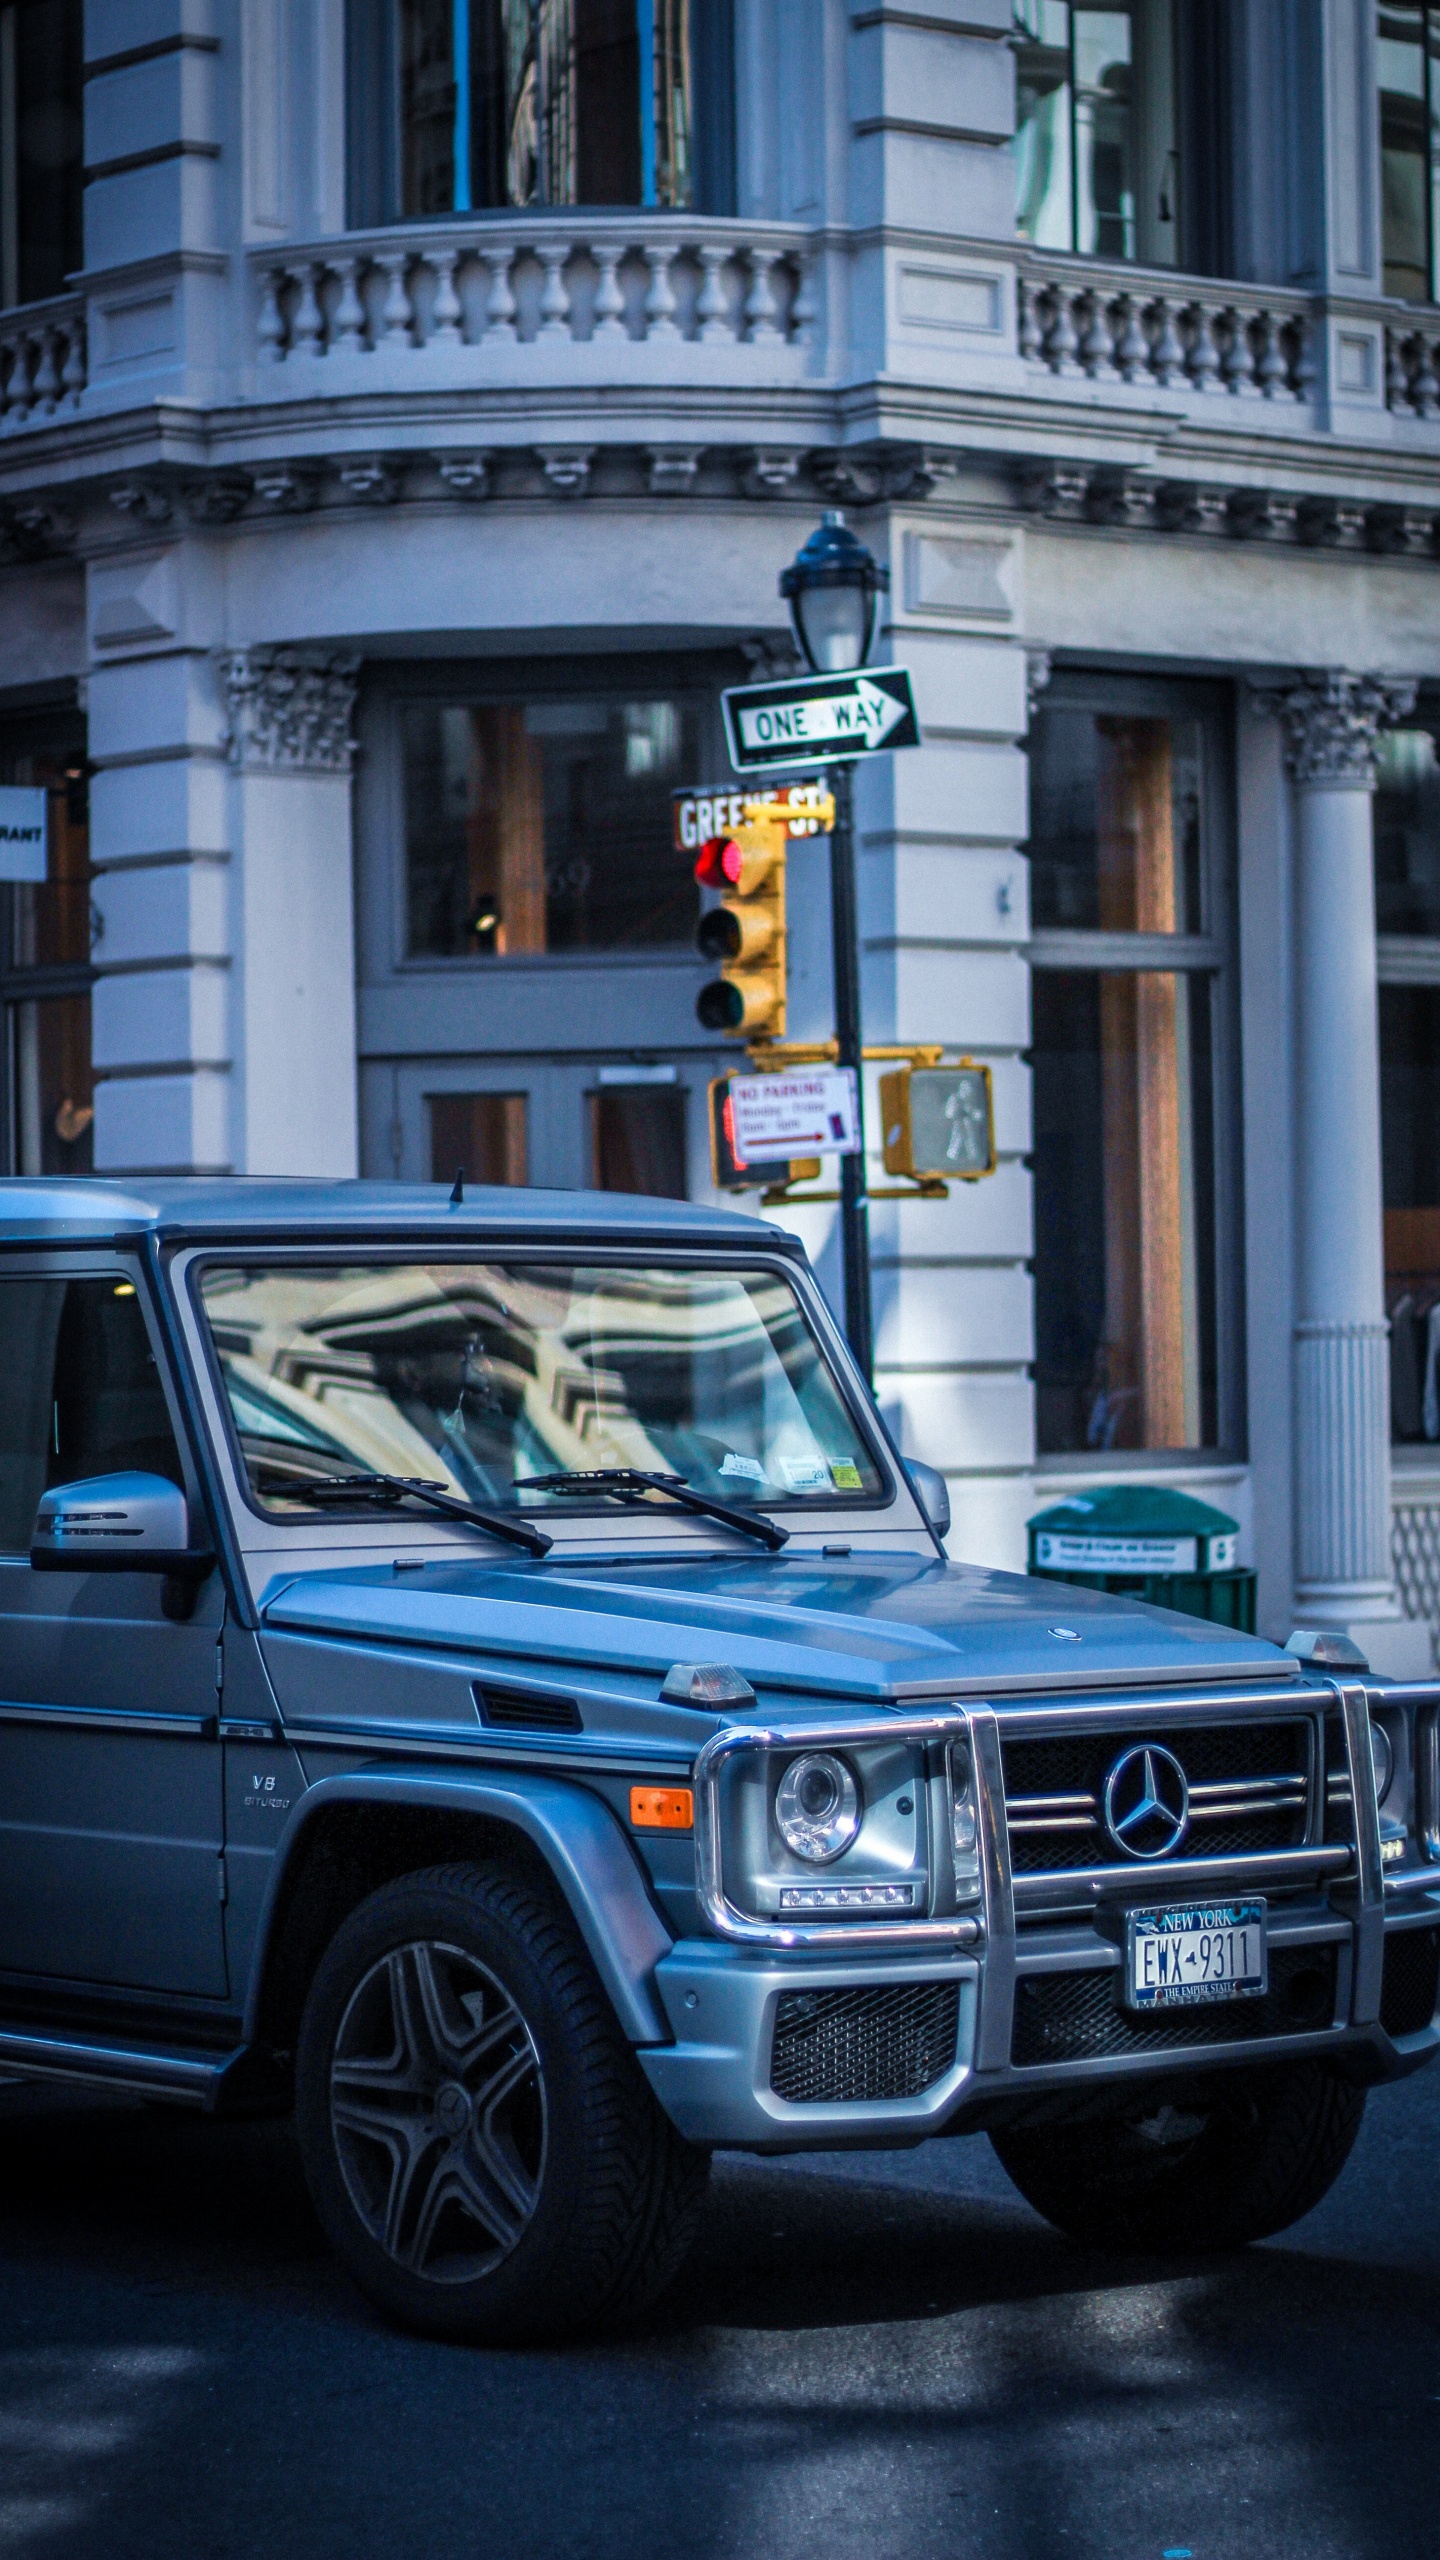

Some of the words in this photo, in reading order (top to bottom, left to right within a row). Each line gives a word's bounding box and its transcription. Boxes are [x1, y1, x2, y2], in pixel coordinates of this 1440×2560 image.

[757, 708, 808, 741] ONE
[831, 698, 885, 729] WAY
[252, 1775, 276, 1791] V8
[1163, 1912, 1195, 1933] NEW
[1197, 1908, 1232, 1930] YORK
[1144, 1937, 1183, 1987] EWX
[1199, 1930, 1249, 1980] 9311
[1164, 1988, 1180, 1998] THE
[1181, 1984, 1210, 1997] EMPIRE
[1210, 1982, 1232, 1993] STATE
